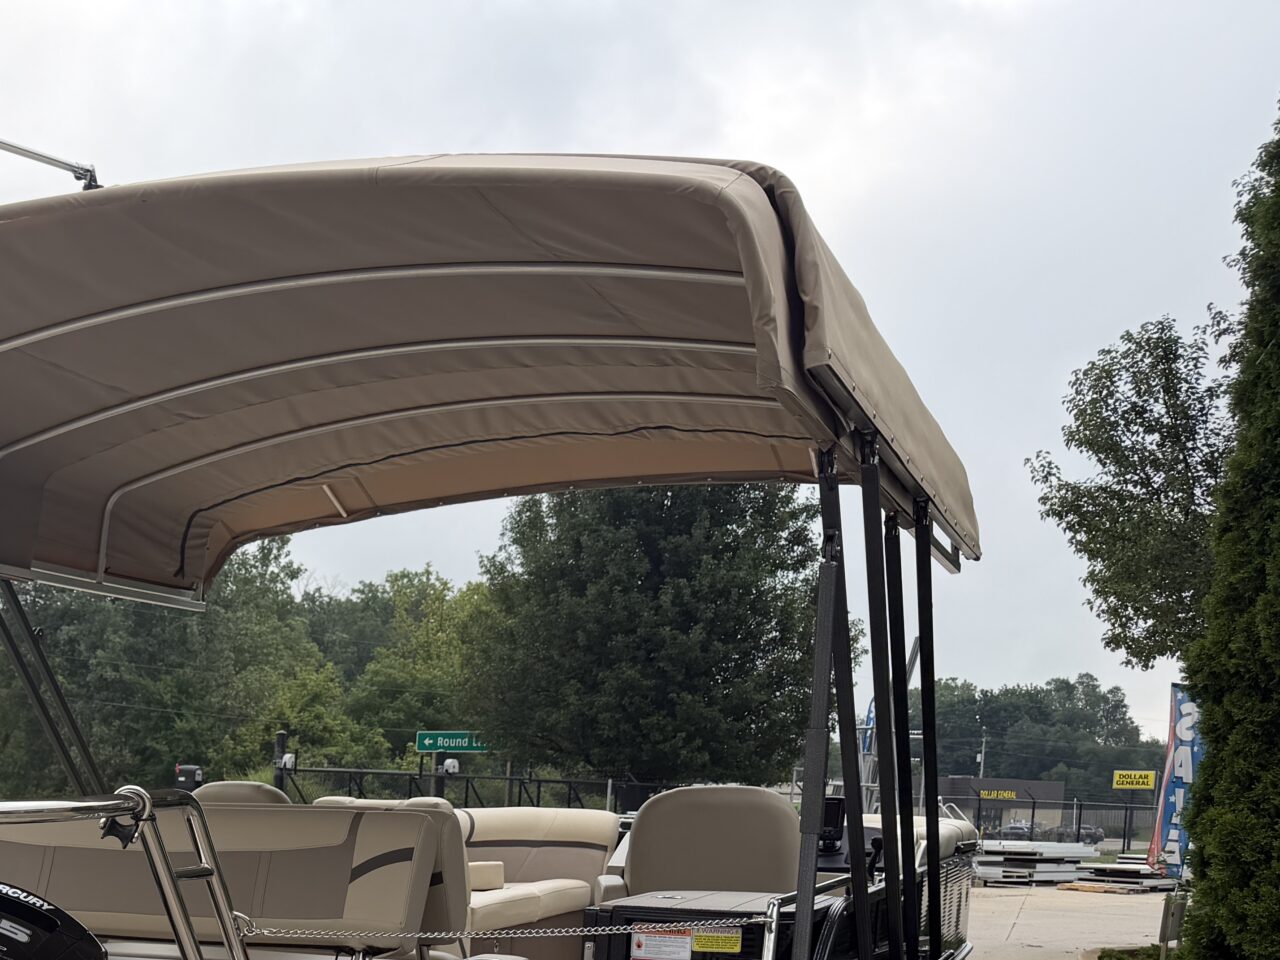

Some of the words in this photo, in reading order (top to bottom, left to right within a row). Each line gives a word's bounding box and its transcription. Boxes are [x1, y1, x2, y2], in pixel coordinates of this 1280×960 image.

[437, 737, 468, 747] Round
[980, 790, 997, 799] DOLLAR
[998, 790, 1017, 800] GENERAL
[702, 927, 734, 935] WARNING
